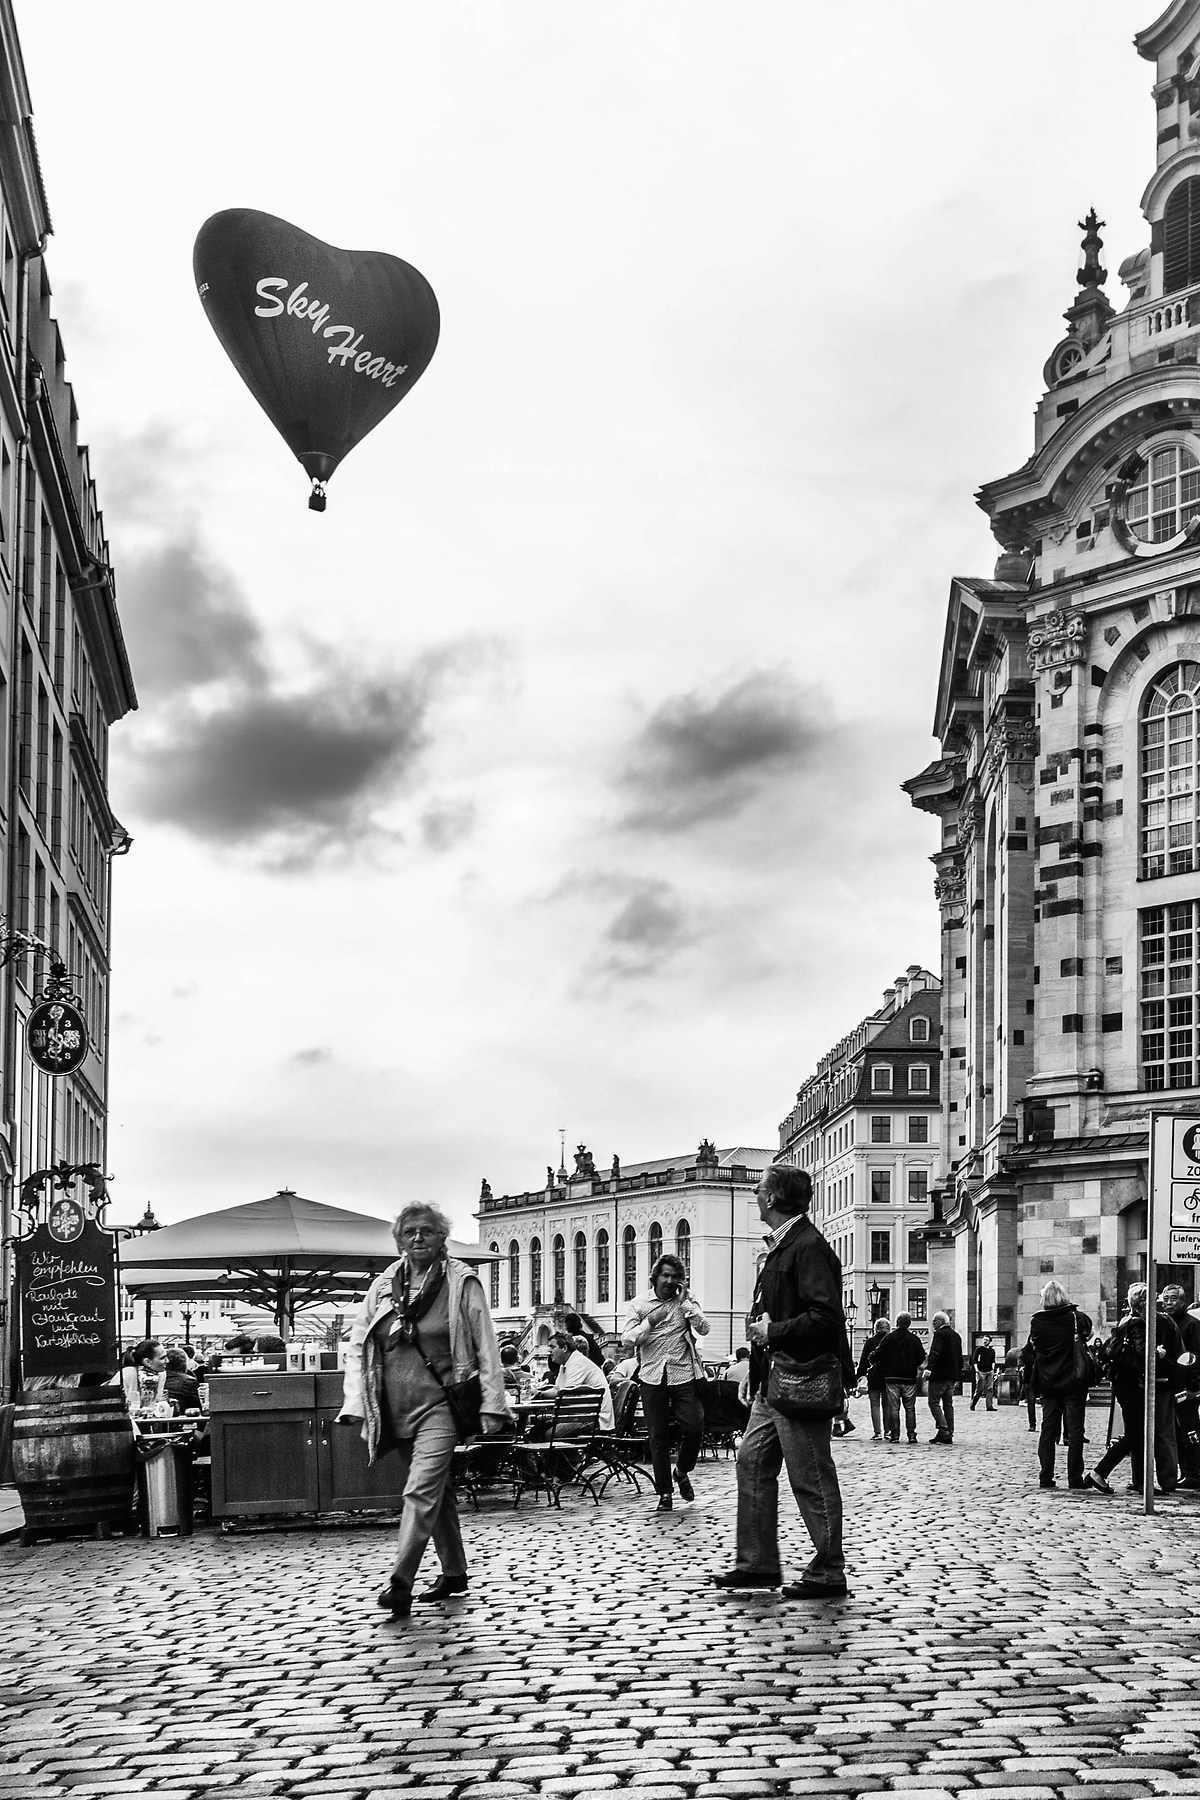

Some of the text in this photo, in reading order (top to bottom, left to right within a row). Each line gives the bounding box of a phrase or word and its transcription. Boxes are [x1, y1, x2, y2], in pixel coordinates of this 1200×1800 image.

[254, 277, 408, 388] Sky Heart
[31, 1251, 61, 1265] Wir
[33, 1260, 98, 1279] empfehlen
[51, 1323, 79, 1333] und
